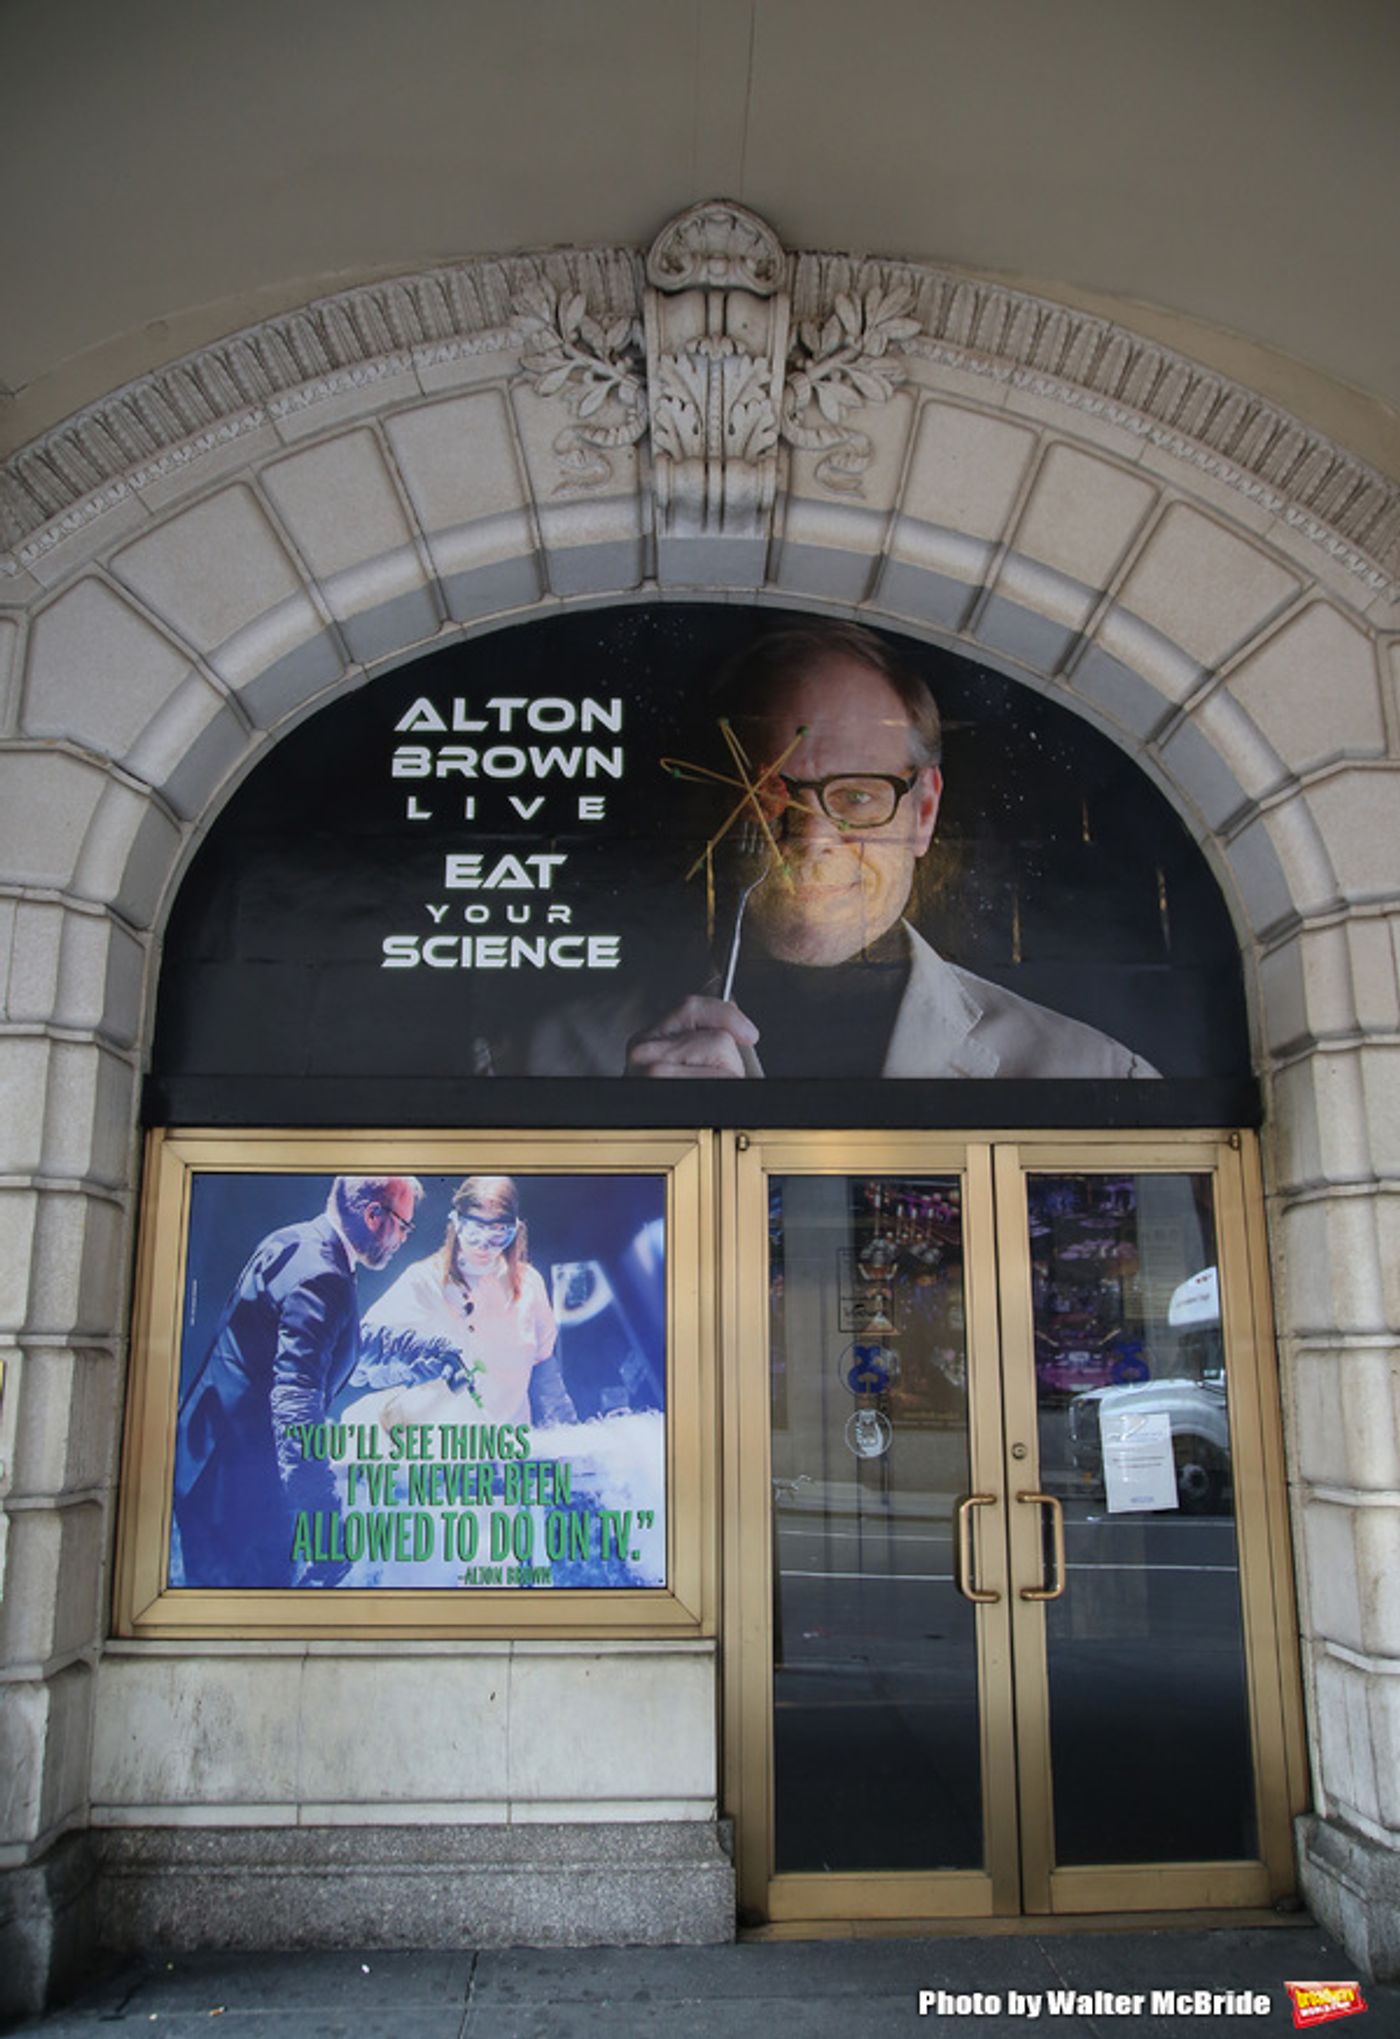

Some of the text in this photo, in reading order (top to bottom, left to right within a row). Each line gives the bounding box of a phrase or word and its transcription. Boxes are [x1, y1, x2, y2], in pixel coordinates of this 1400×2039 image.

[393, 697, 623, 733] ALTON
[391, 746, 623, 779] BROWN
[406, 796, 607, 820] LIVE
[444, 854, 569, 890] EAT
[425, 904, 573, 924] YOUR
[381, 935, 622, 969] SCIENCE
[389, 1423, 435, 1461] SEE
[438, 1423, 531, 1461] THINGS
[347, 1462, 572, 1507] I'VE NEVER BEEN
[290, 1510, 435, 1563] ALLOWED
[441, 1510, 480, 1563] TO
[490, 1510, 535, 1563] DO
[545, 1510, 591, 1563] ON
[506, 1566, 552, 1585] BROWN
